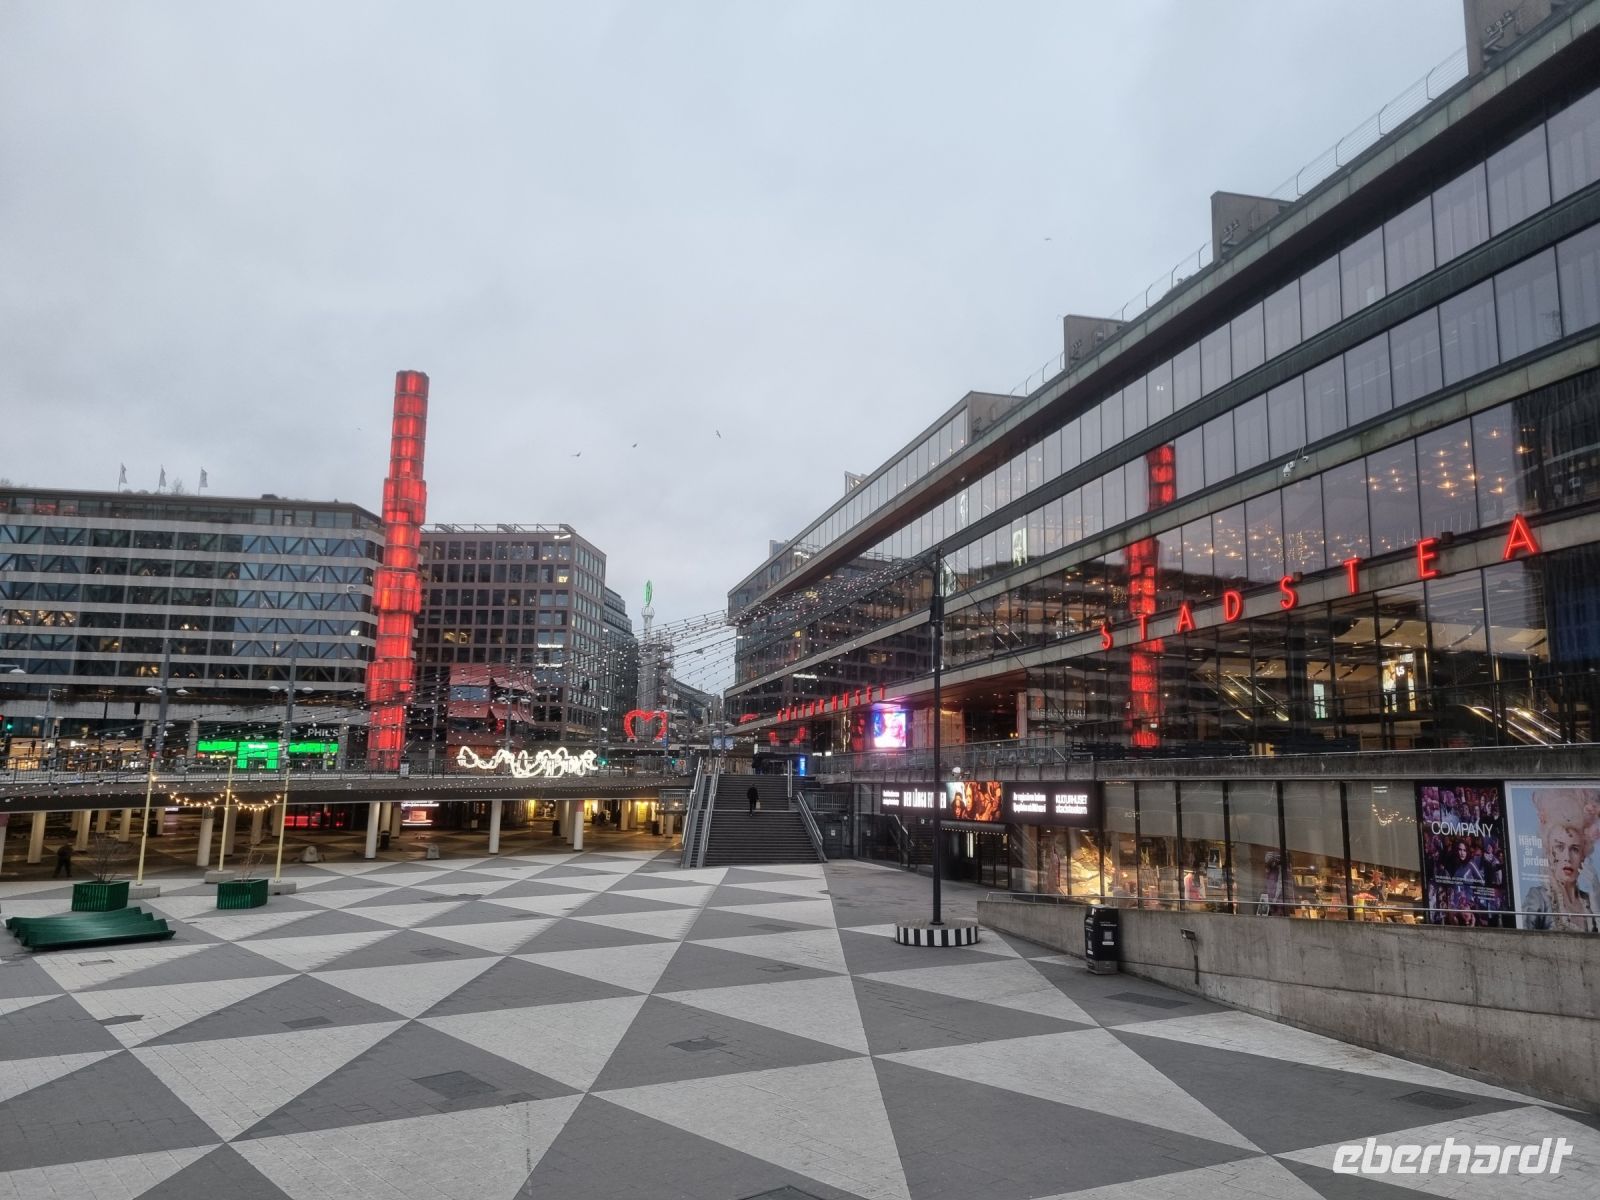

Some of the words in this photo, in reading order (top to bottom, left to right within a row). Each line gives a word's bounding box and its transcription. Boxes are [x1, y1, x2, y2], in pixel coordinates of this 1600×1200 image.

[1100, 513, 1542, 651] STADSTEA
[307, 728, 340, 737] PHIL'S
[1431, 821, 1494, 837] COMPANY
[1518, 834, 1543, 848] Härlig
[1524, 848, 1534, 856] är
[1523, 857, 1549, 867] jorden
